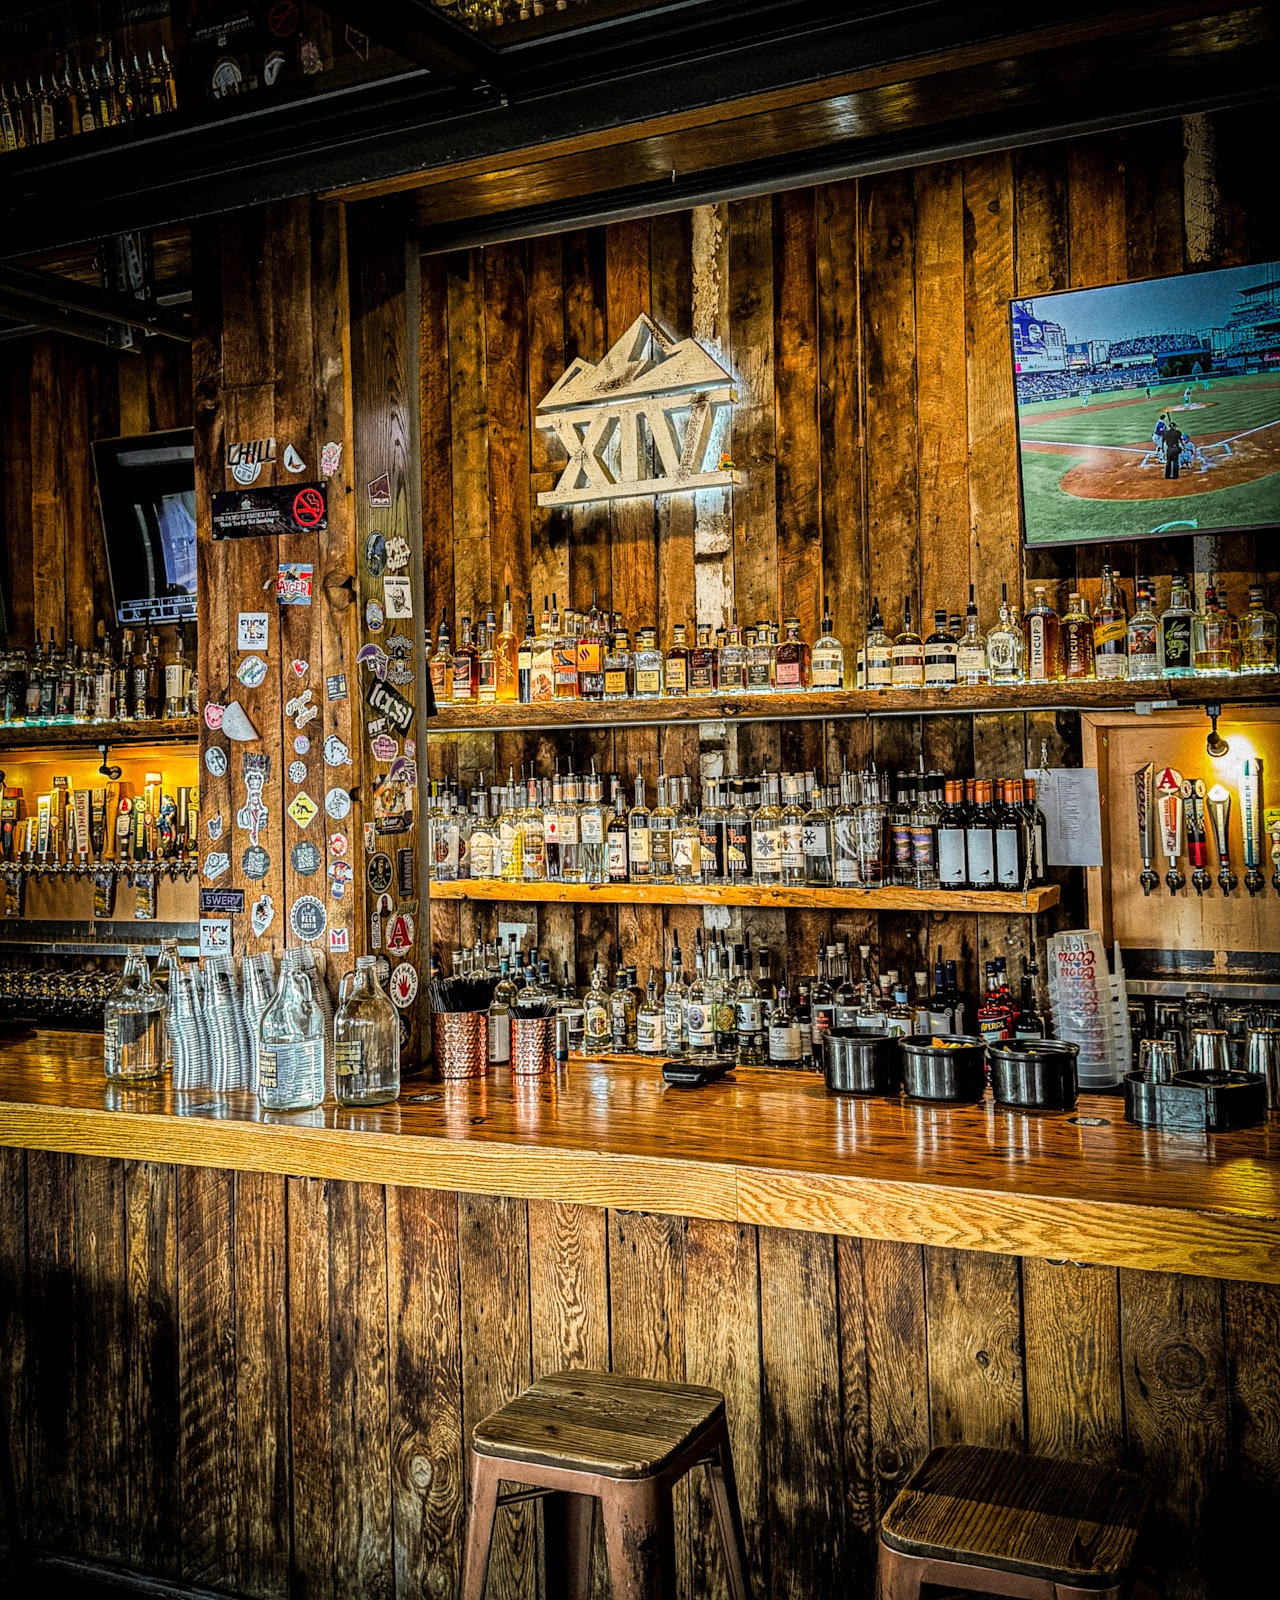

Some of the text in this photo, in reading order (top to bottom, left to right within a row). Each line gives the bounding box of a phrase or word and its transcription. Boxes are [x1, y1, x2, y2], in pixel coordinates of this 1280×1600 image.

[227, 439, 276, 467] CHILL
[545, 394, 724, 498] XIV
[247, 511, 266, 519] SMOKE
[1033, 629, 1042, 666] TINCUP
[1069, 633, 1079, 670] TINCUP
[1157, 766, 1181, 790] A
[76, 794, 87, 839] SNOWMELT
[302, 915, 317, 923] BEER
[385, 915, 414, 949] A
[401, 965, 417, 984] HAND
[980, 1021, 1005, 1032] APEROL
